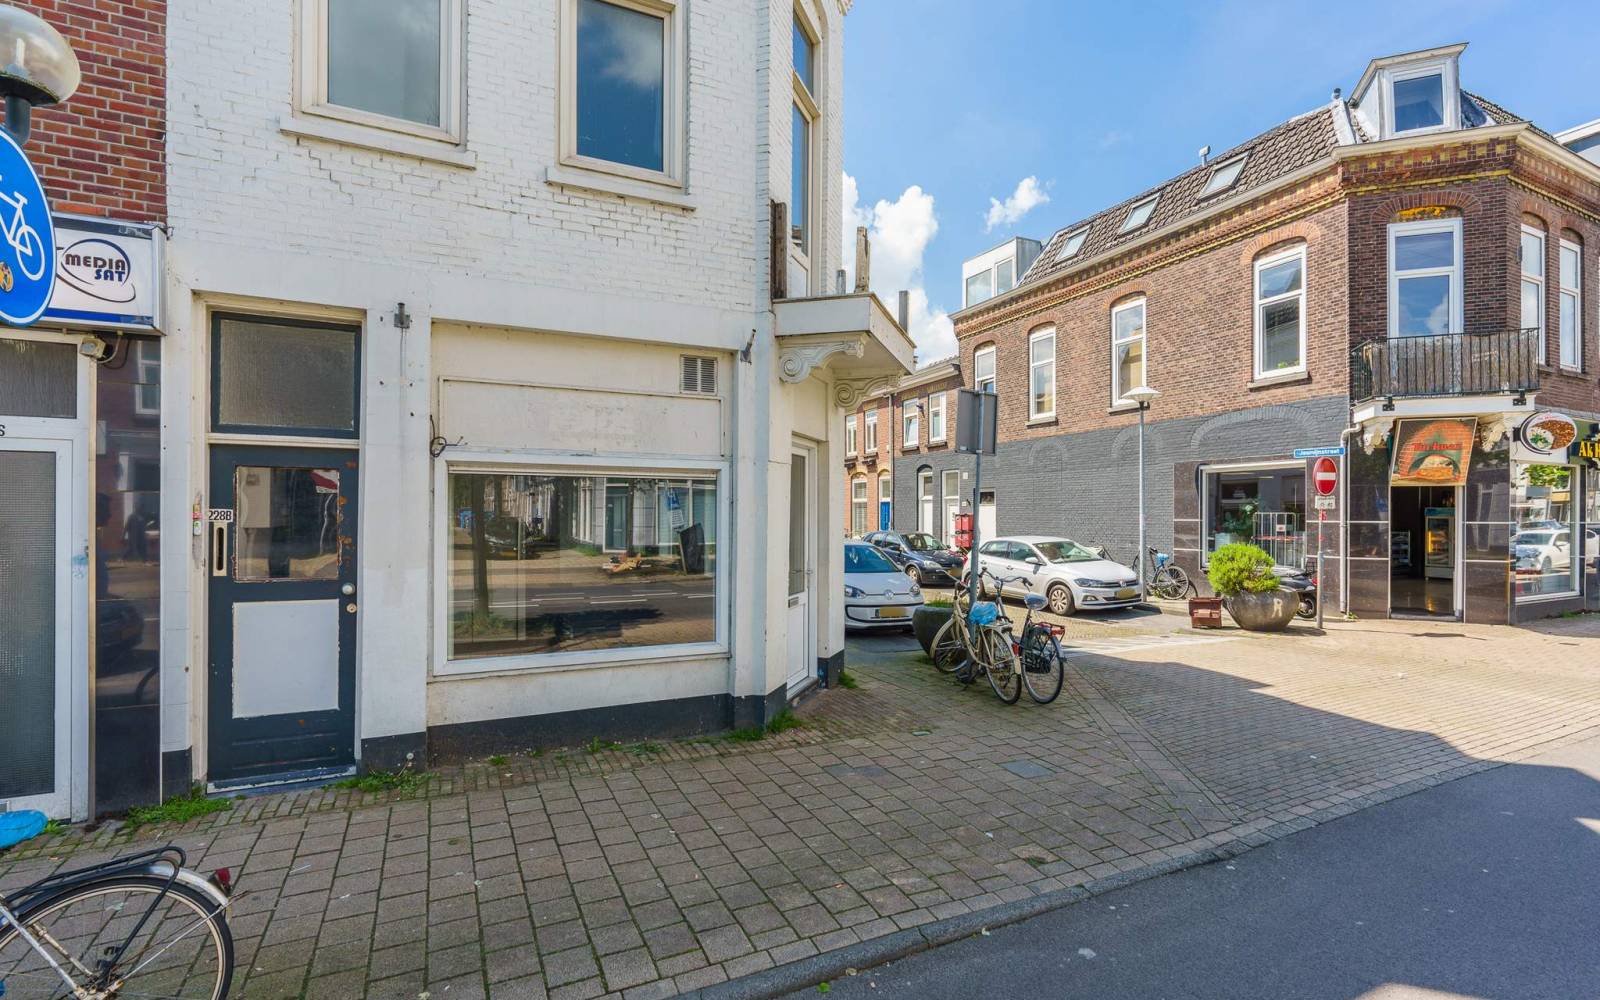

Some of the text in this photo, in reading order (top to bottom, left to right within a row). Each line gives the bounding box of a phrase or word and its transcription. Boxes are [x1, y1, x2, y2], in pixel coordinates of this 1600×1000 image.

[65, 254, 126, 271] MEDIA
[94, 269, 126, 282] SAT
[208, 510, 232, 521] 228B
